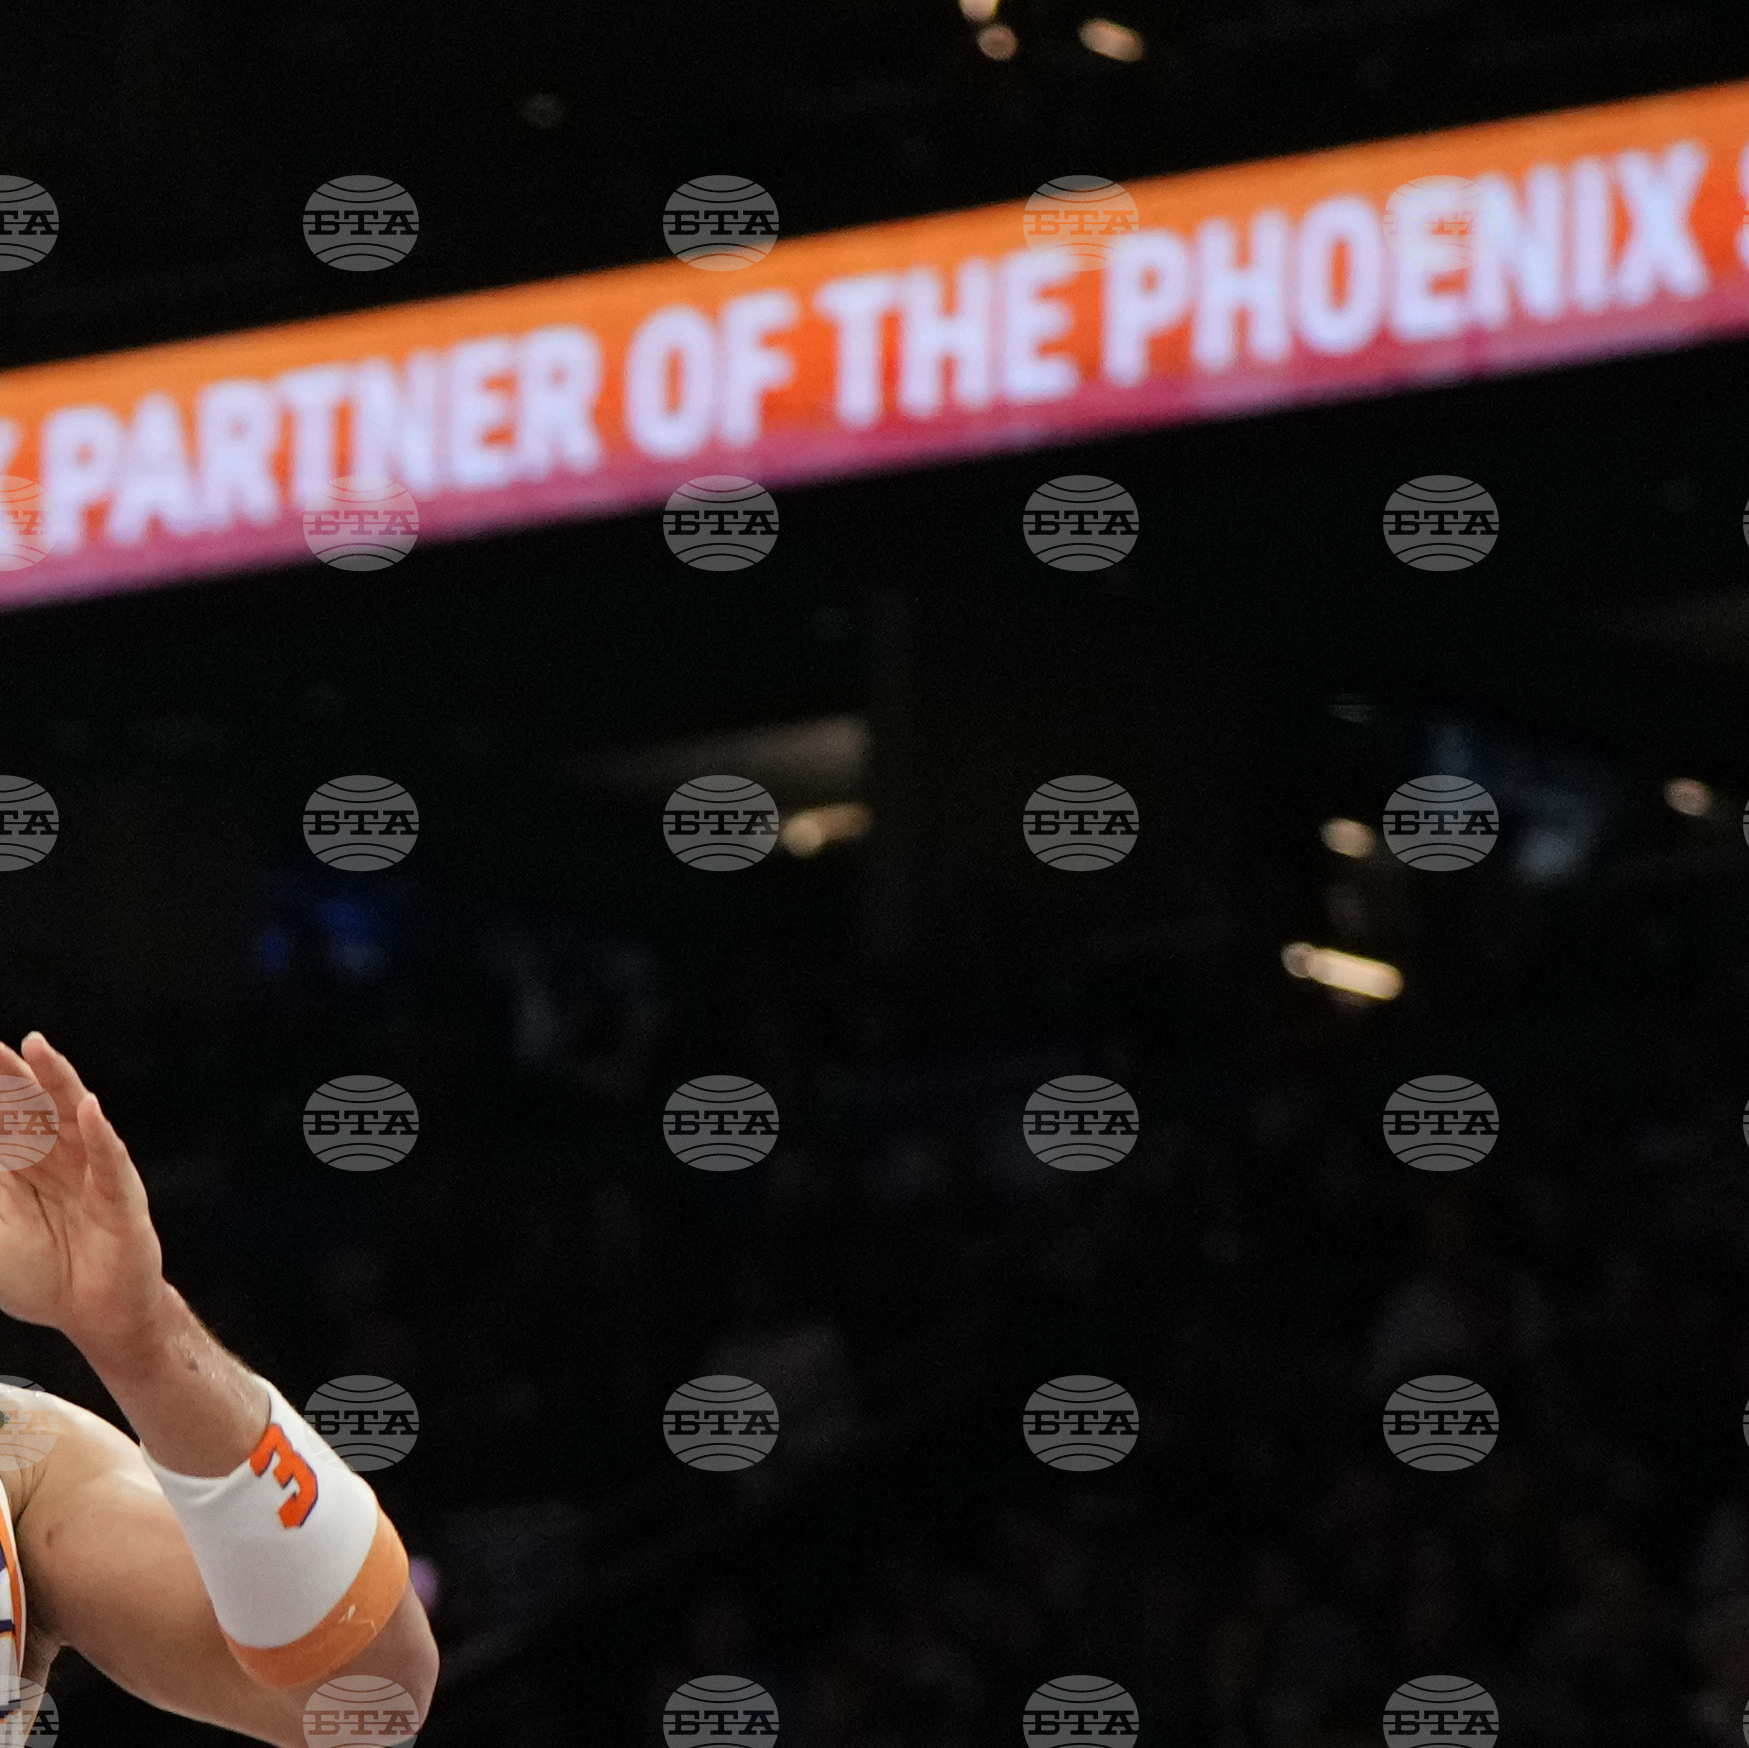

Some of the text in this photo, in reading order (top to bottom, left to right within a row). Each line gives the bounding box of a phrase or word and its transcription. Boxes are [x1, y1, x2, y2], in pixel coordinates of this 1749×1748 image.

[41, 325, 601, 556] PARTNER
[624, 287, 799, 459] OF
[812, 246, 1080, 429] THE
[1102, 140, 1711, 389] PHOENIX
[250, 1424, 318, 1530] 3
